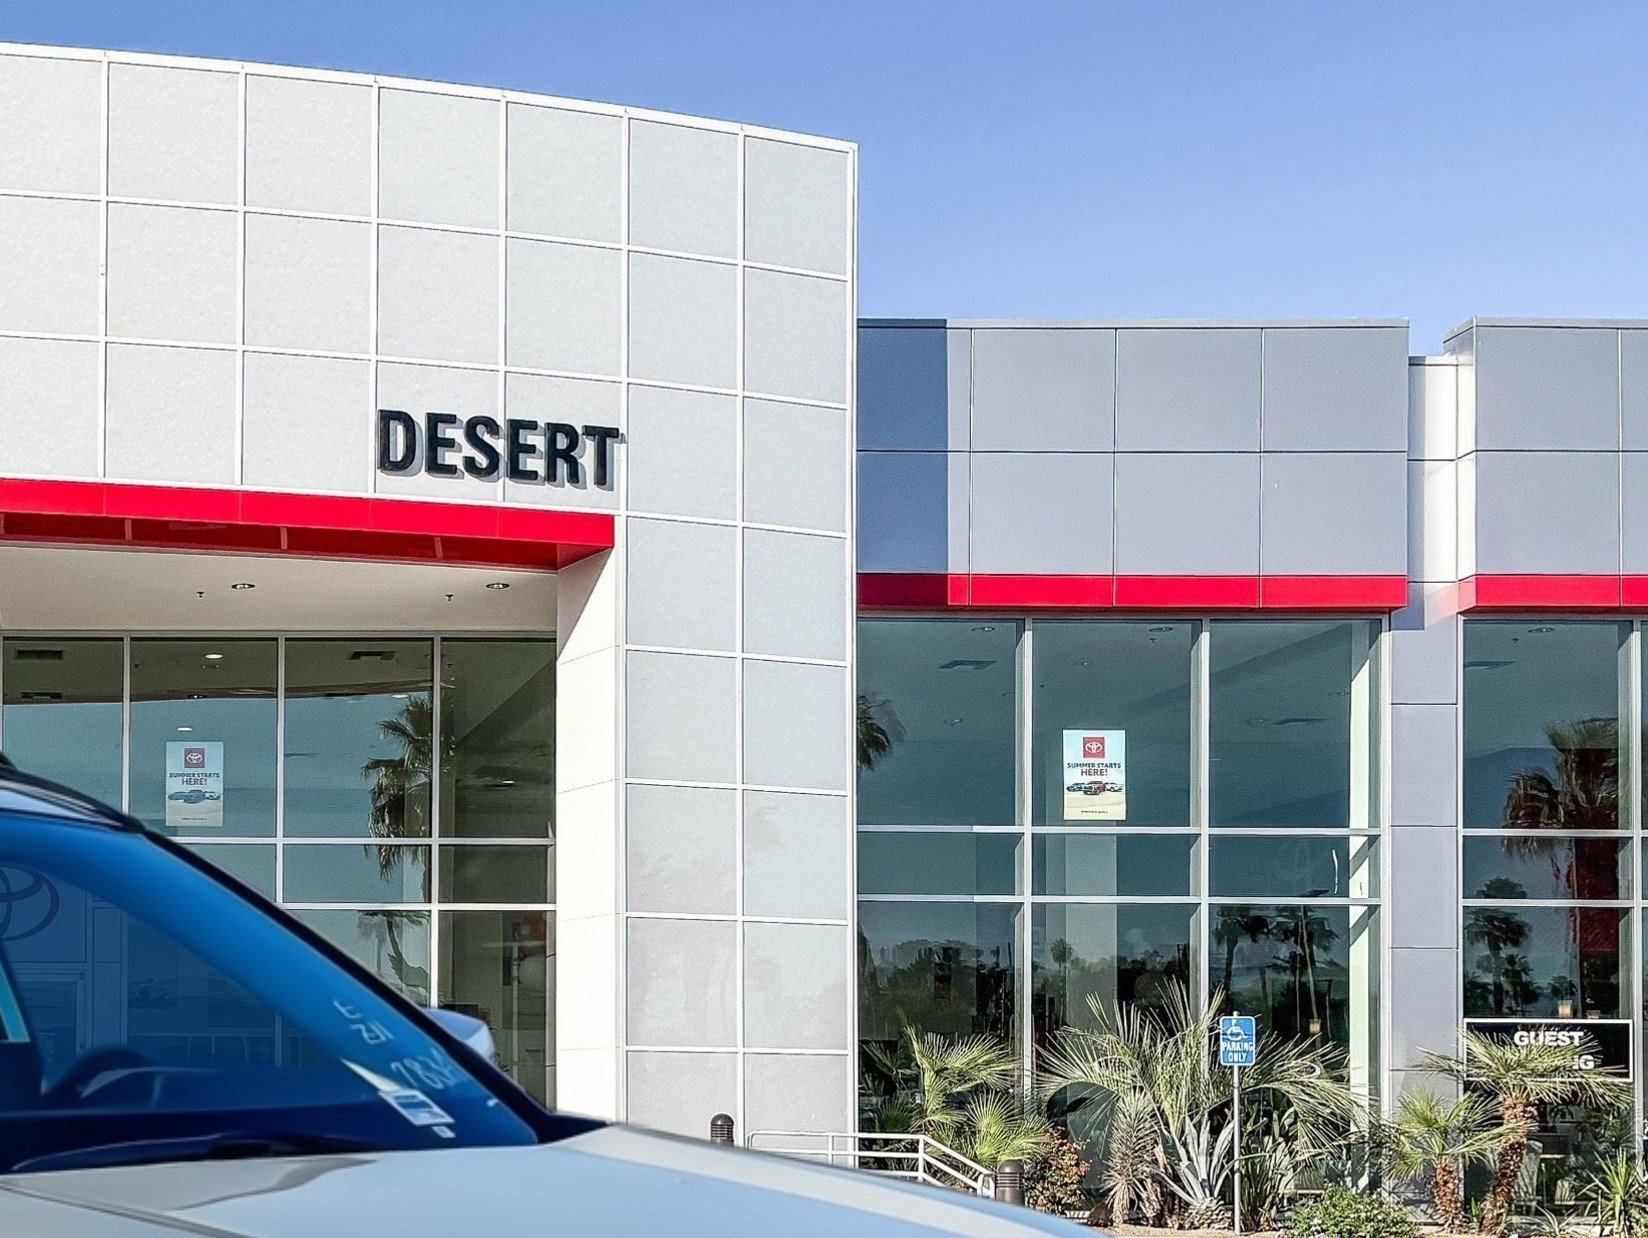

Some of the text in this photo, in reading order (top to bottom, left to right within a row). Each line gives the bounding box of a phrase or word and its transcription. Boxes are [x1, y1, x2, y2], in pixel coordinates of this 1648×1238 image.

[376, 409, 621, 487] DESERT
[1080, 768, 1108, 777] HERE!
[181, 777, 208, 786] HERE!
[1514, 1031, 1584, 1046] GUEST
[1223, 1041, 1253, 1052] PARKING
[1228, 1052, 1247, 1062] ONLY
